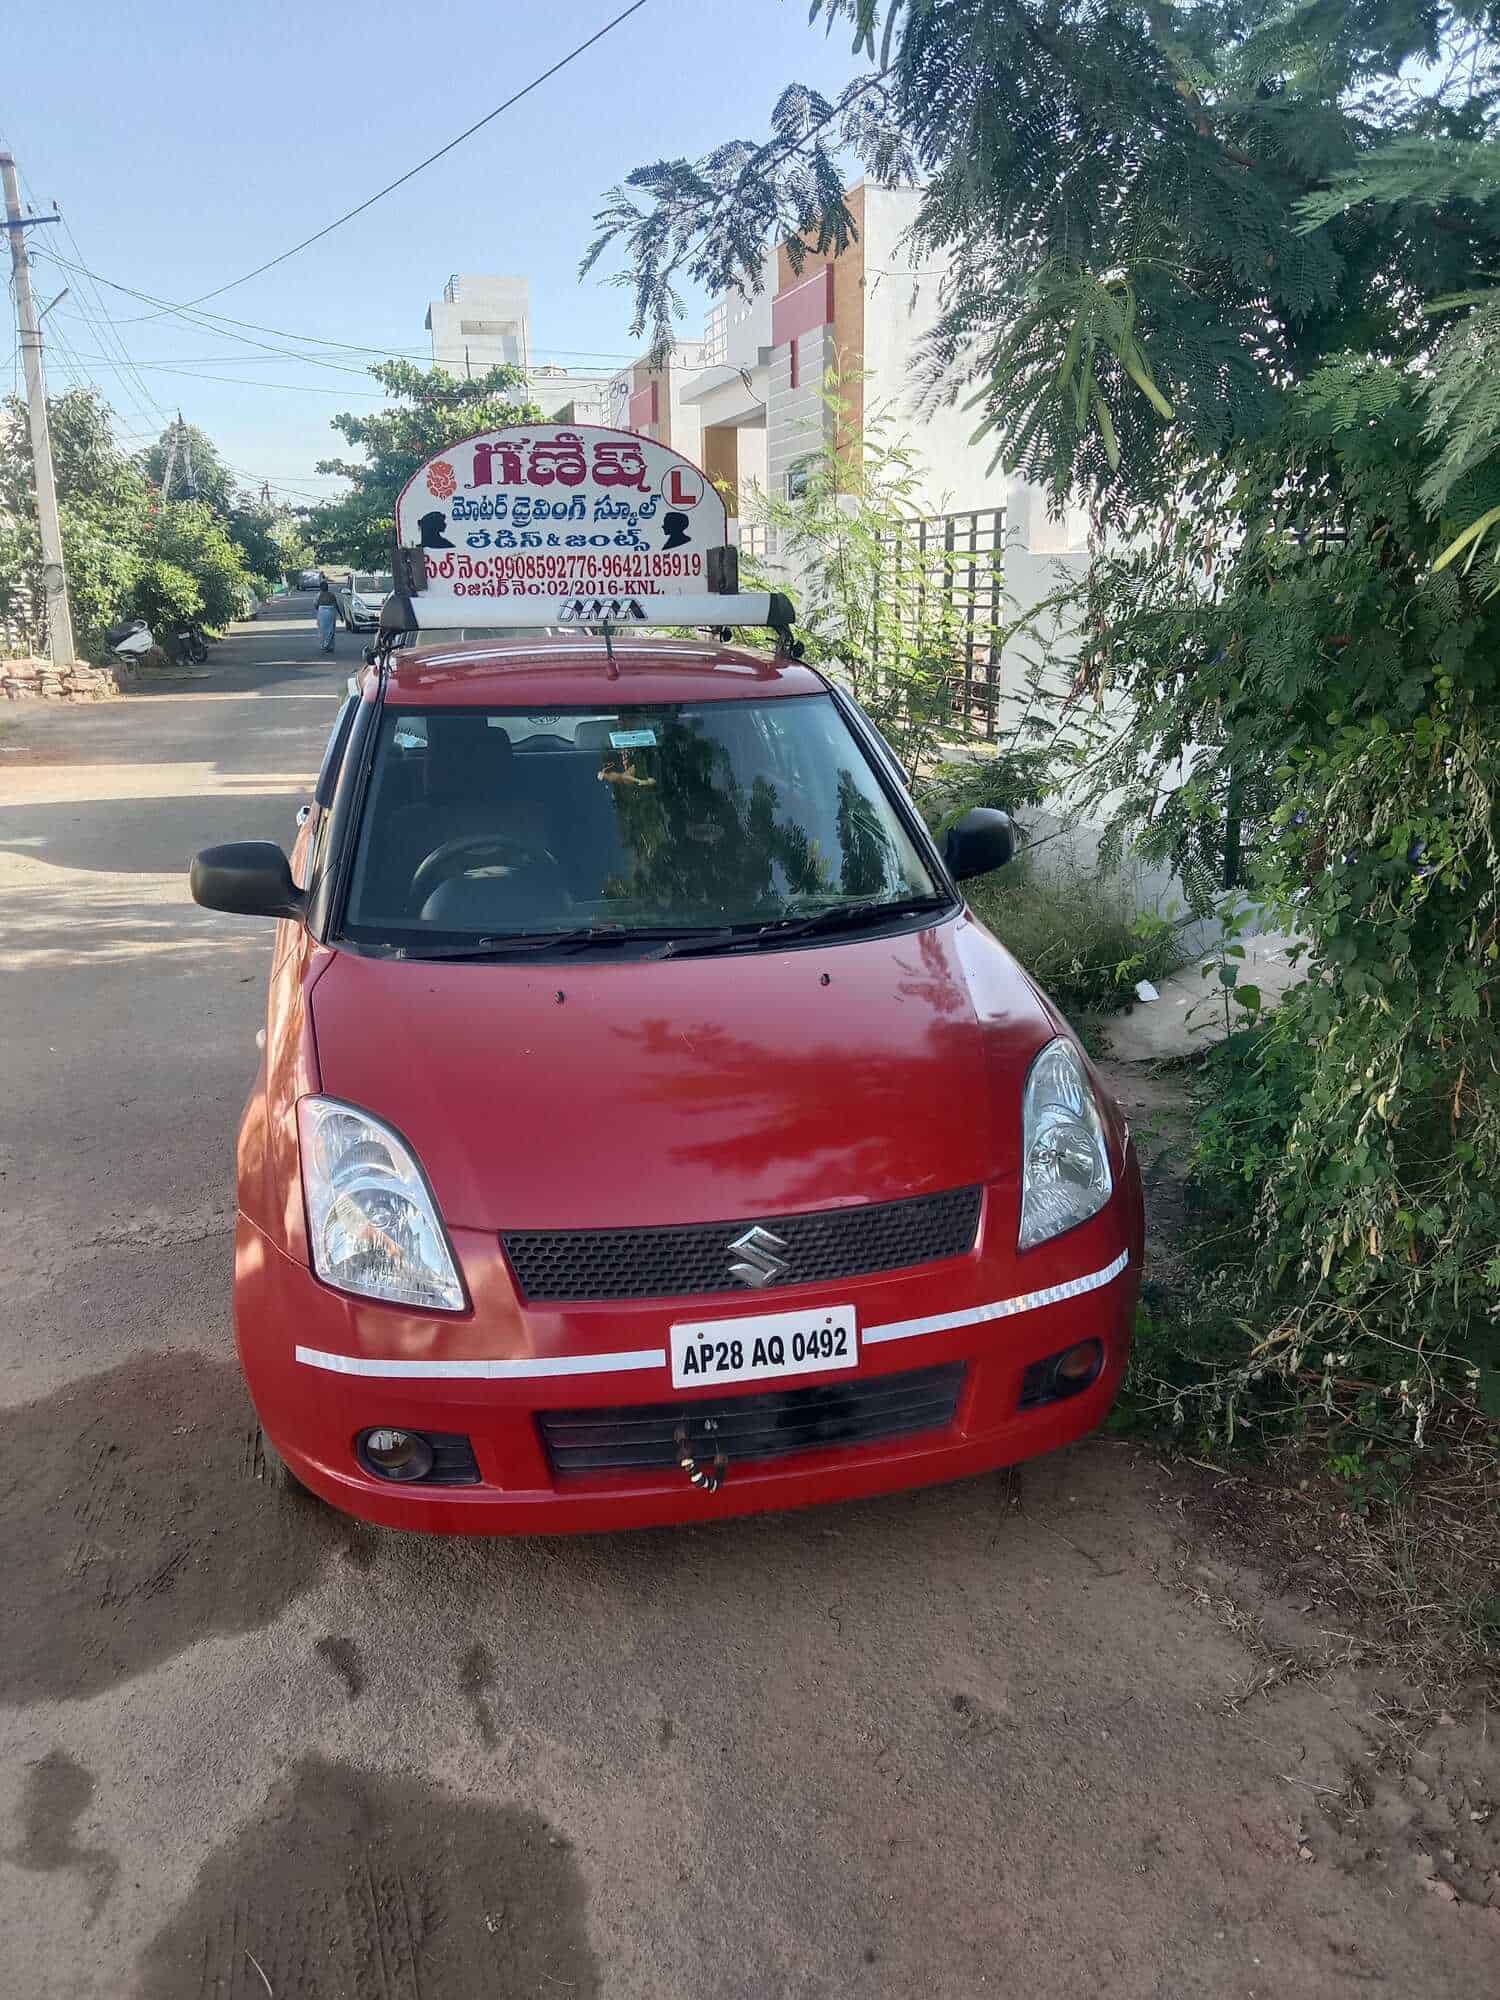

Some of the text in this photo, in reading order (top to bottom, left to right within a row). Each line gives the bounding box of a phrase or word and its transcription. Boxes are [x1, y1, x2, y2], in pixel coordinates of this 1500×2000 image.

[464, 432, 651, 493] గణేష్
[671, 470, 696, 504] L
[593, 494, 661, 527] స్కూల్
[547, 532, 561, 547] &
[683, 1327, 848, 1375] AP28 AQ 0492
